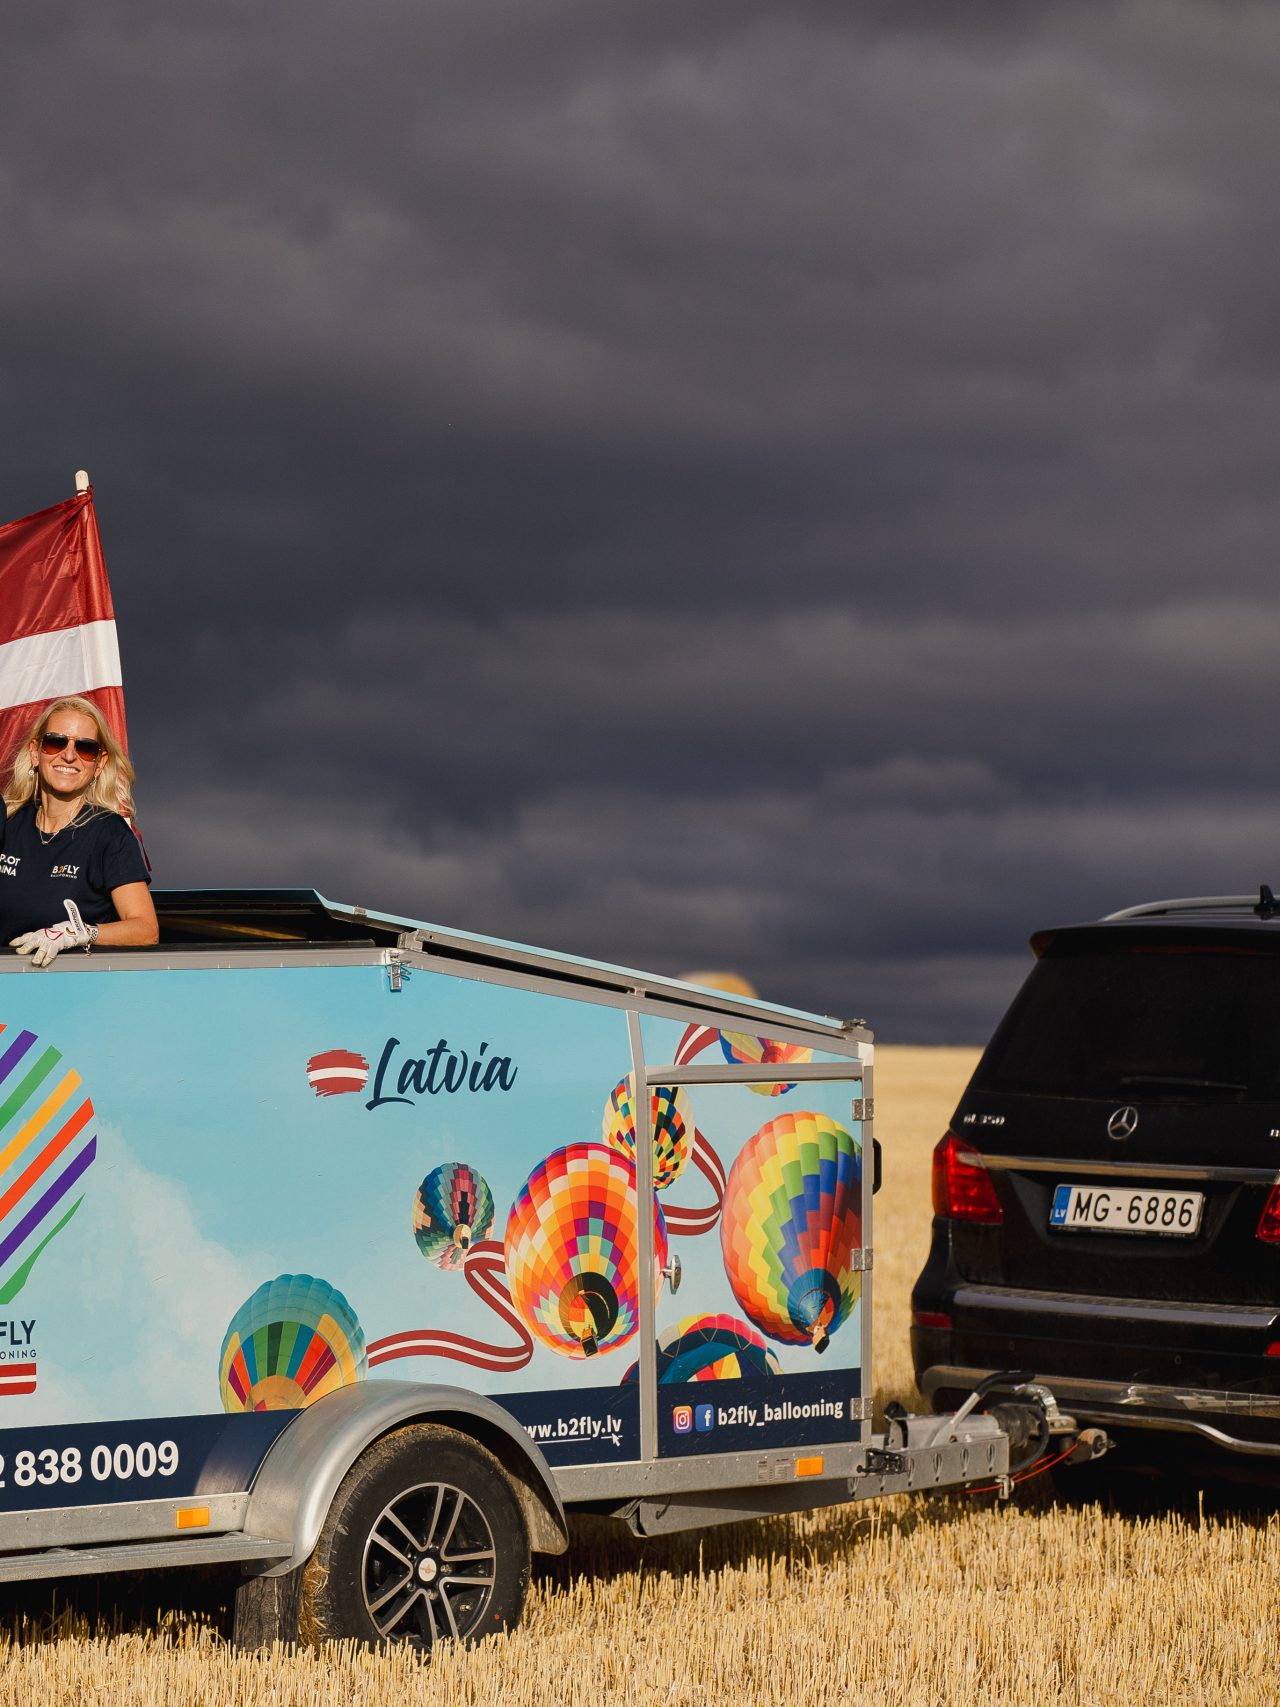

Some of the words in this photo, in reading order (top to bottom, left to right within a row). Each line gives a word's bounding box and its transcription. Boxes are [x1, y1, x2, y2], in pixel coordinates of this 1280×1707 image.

[365, 1037, 518, 1111] Latvia
[1054, 1208, 1067, 1218] LV
[1072, 1191, 1195, 1228] MG-6886
[718, 1398, 844, 1427] b2fly_ballooning
[90, 1440, 179, 1481] 0009
